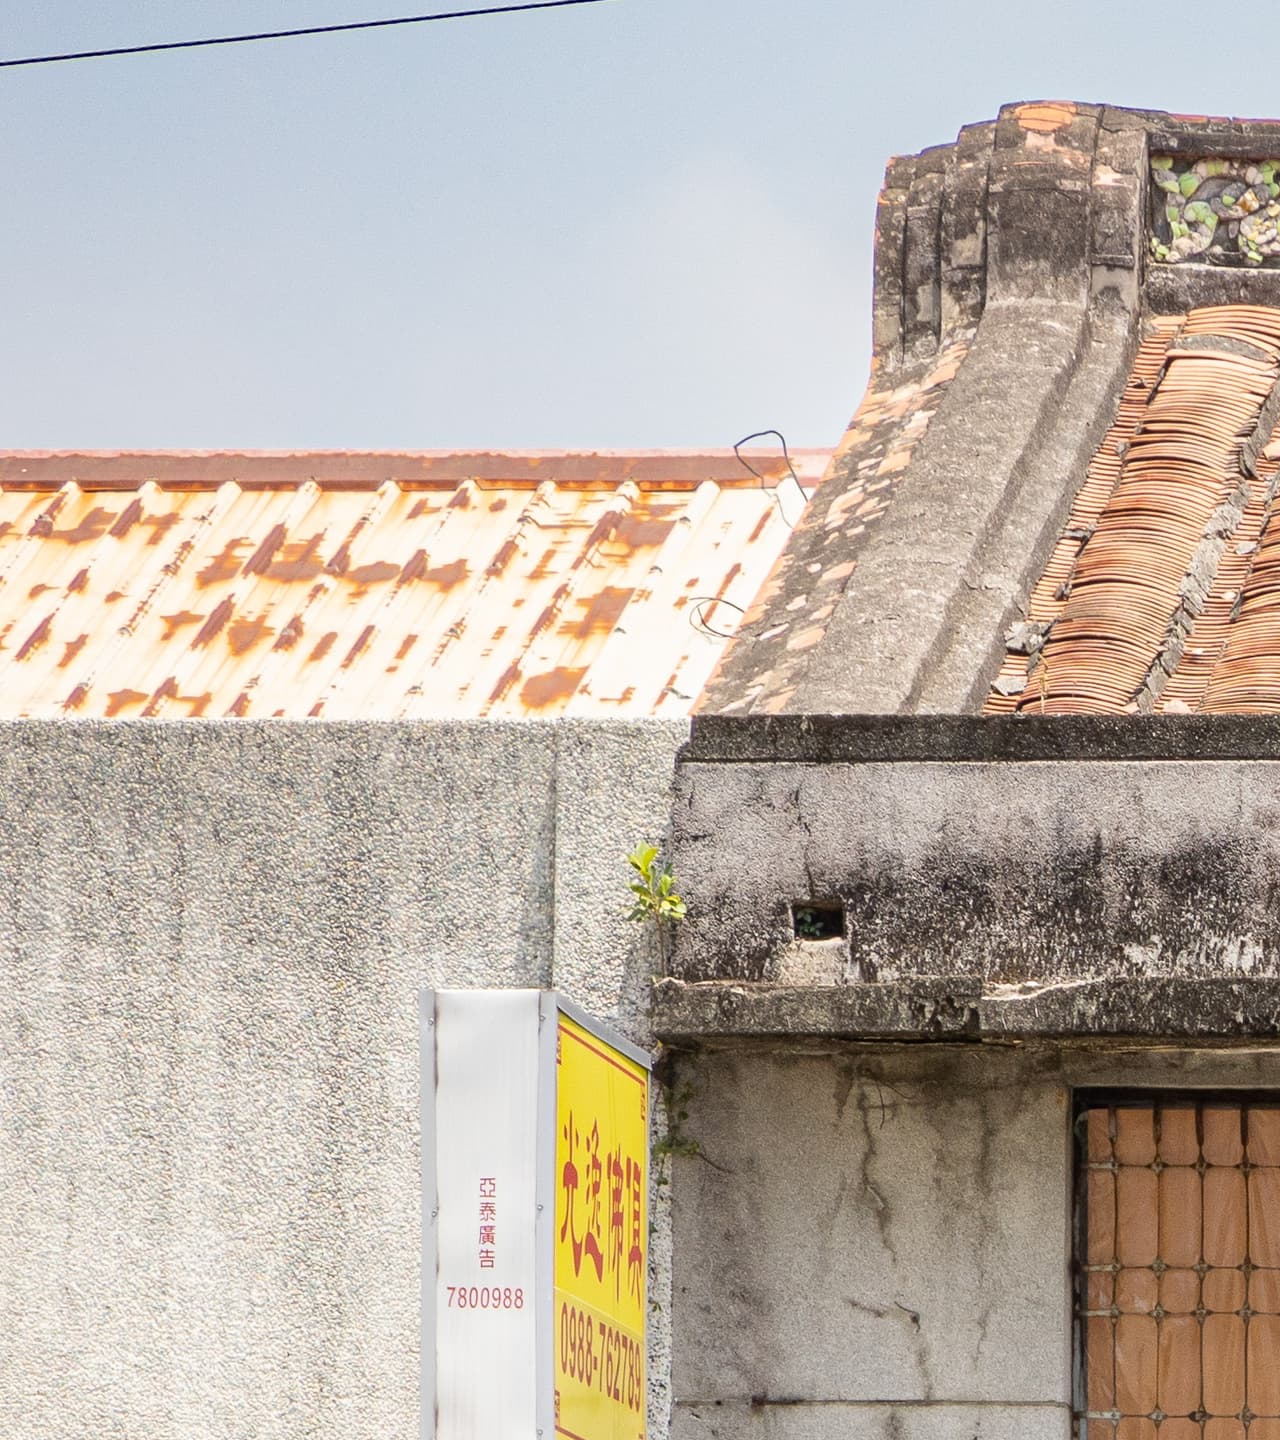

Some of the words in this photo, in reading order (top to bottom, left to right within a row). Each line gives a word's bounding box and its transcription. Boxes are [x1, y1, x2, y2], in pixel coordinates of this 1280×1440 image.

[479, 1177, 496, 1269] 亞泰廣告
[446, 1286, 524, 1310] 7800988
[560, 1301, 642, 1415] 0988-762789
